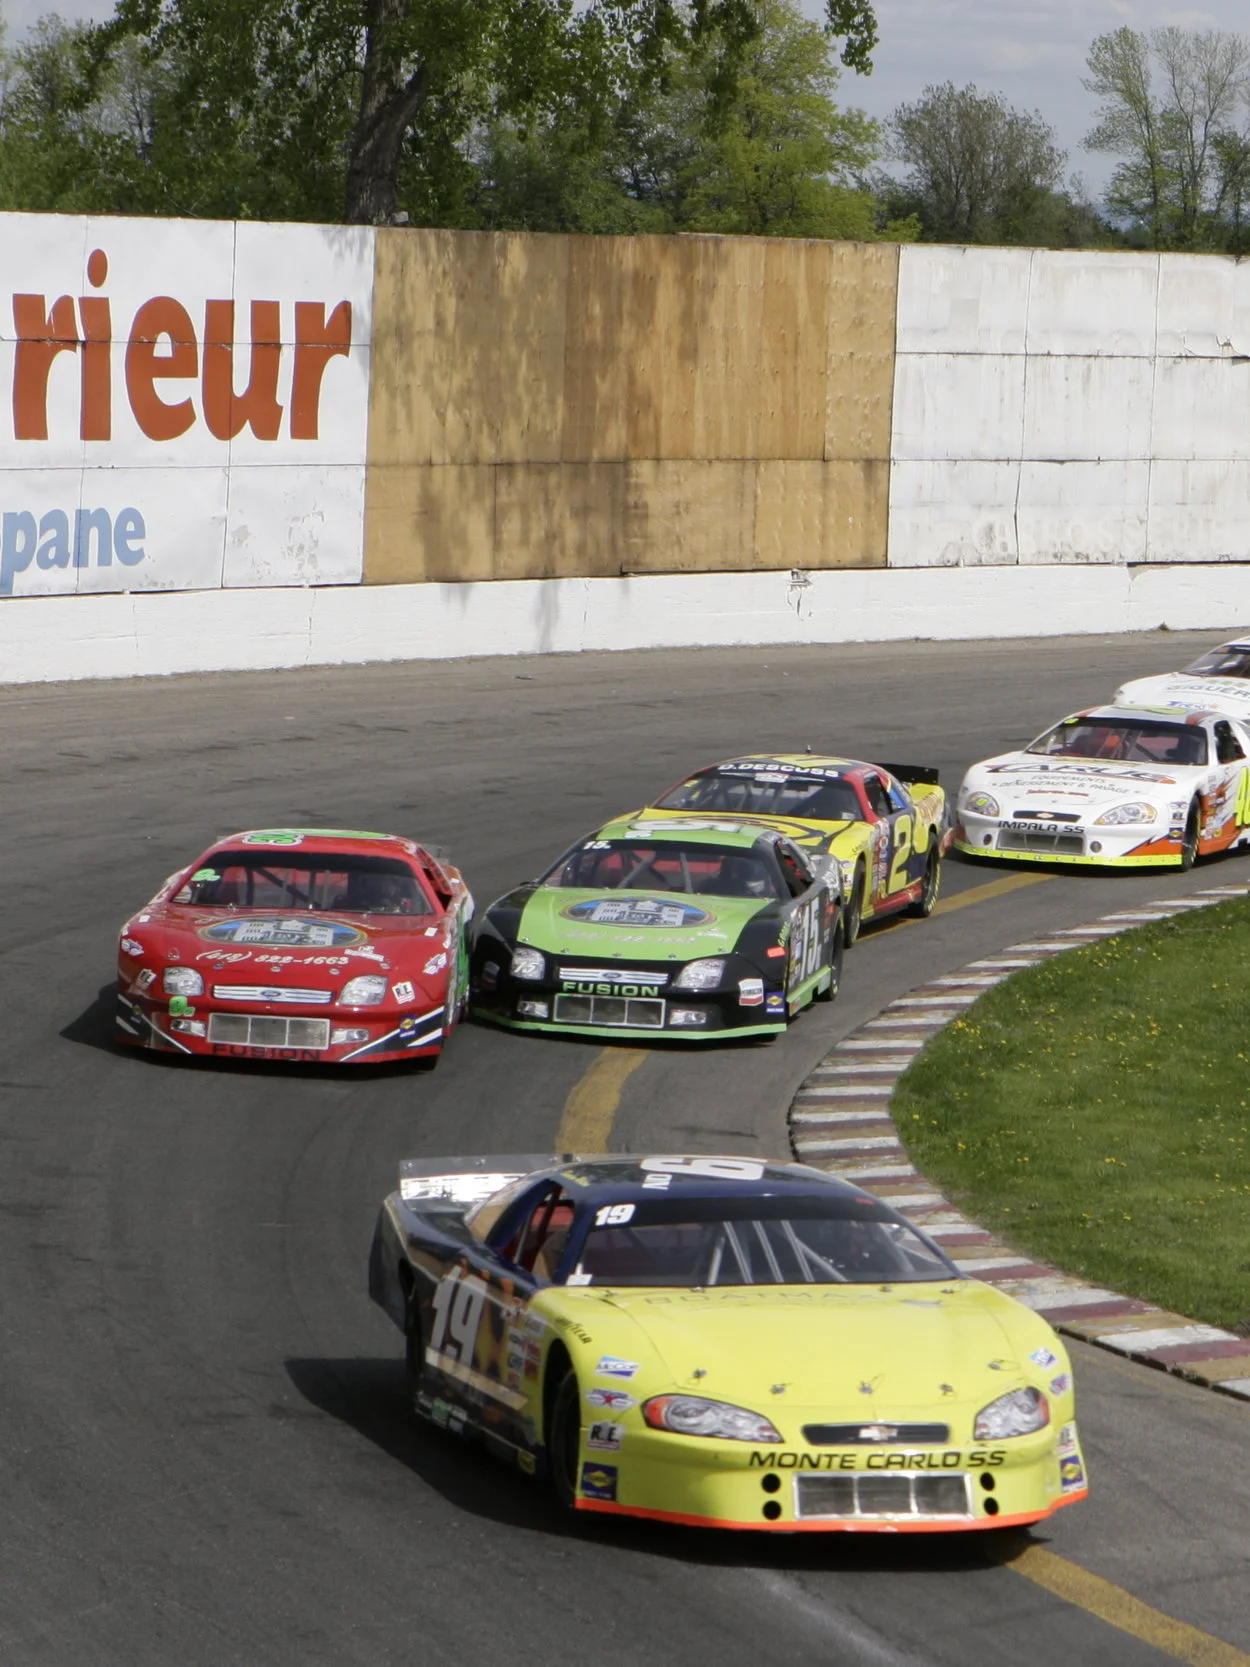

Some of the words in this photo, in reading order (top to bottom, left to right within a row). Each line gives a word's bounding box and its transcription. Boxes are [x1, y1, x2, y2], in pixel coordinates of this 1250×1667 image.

[12, 248, 352, 441] rieur
[998, 820, 1058, 832] IMPALA
[1063, 825, 1086, 834] SS
[888, 814, 912, 894] 2
[562, 981, 659, 997] FUSION
[213, 1045, 321, 1061] FUSION
[595, 1204, 637, 1226] 19
[430, 1265, 488, 1369] 19
[750, 1451, 856, 1469] MONTE
[866, 1451, 961, 1469] CARLO
[967, 1451, 1007, 1467] SS
